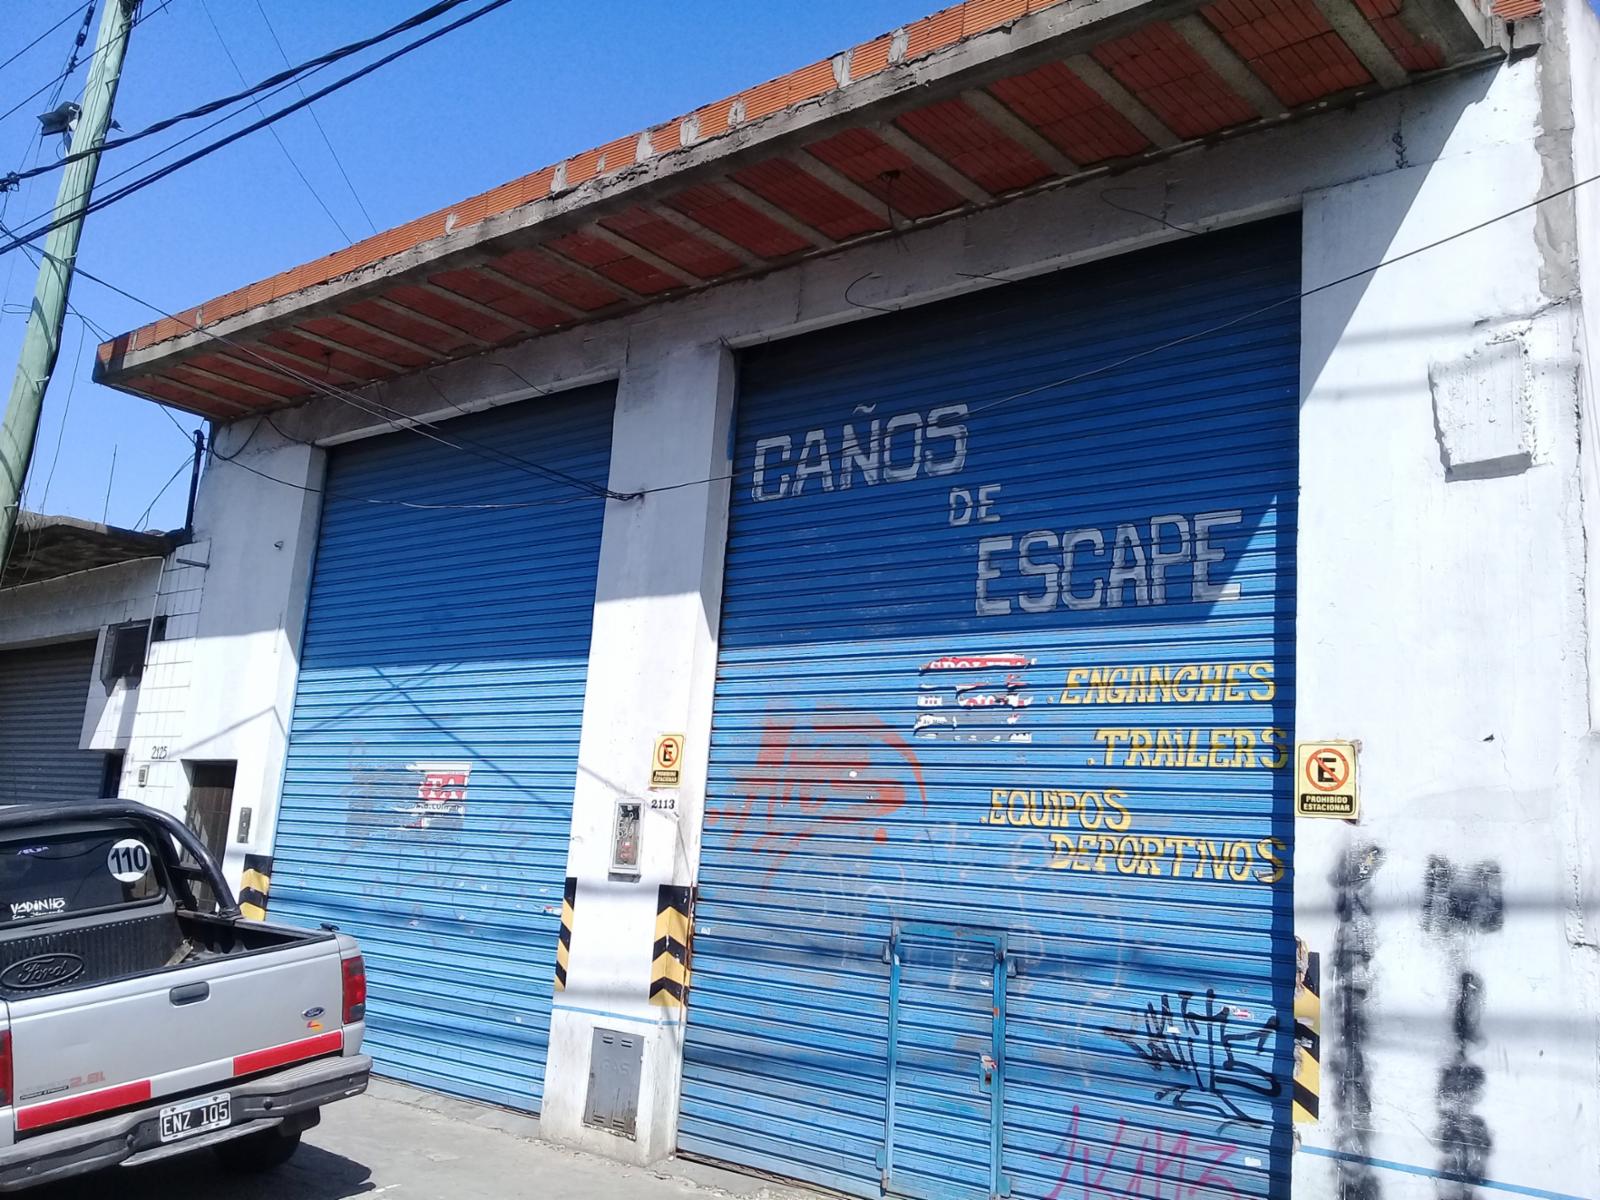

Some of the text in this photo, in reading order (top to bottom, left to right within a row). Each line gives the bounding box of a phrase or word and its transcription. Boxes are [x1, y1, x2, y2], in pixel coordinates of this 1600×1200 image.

[752, 403, 968, 502] CAÑOS
[949, 484, 1001, 526] DE
[976, 510, 1242, 617] ESCAPE
[151, 746, 168, 760] 2125
[651, 799, 675, 809] 2113
[1303, 803, 1351, 812] ESTACIONAR
[1306, 795, 1348, 804] PROHIBIDO
[110, 845, 147, 874] 110
[1049, 833, 1285, 884] DEPORTIVOS
[18, 957, 67, 983] Ford
[163, 1102, 228, 1136] ENZ 105
